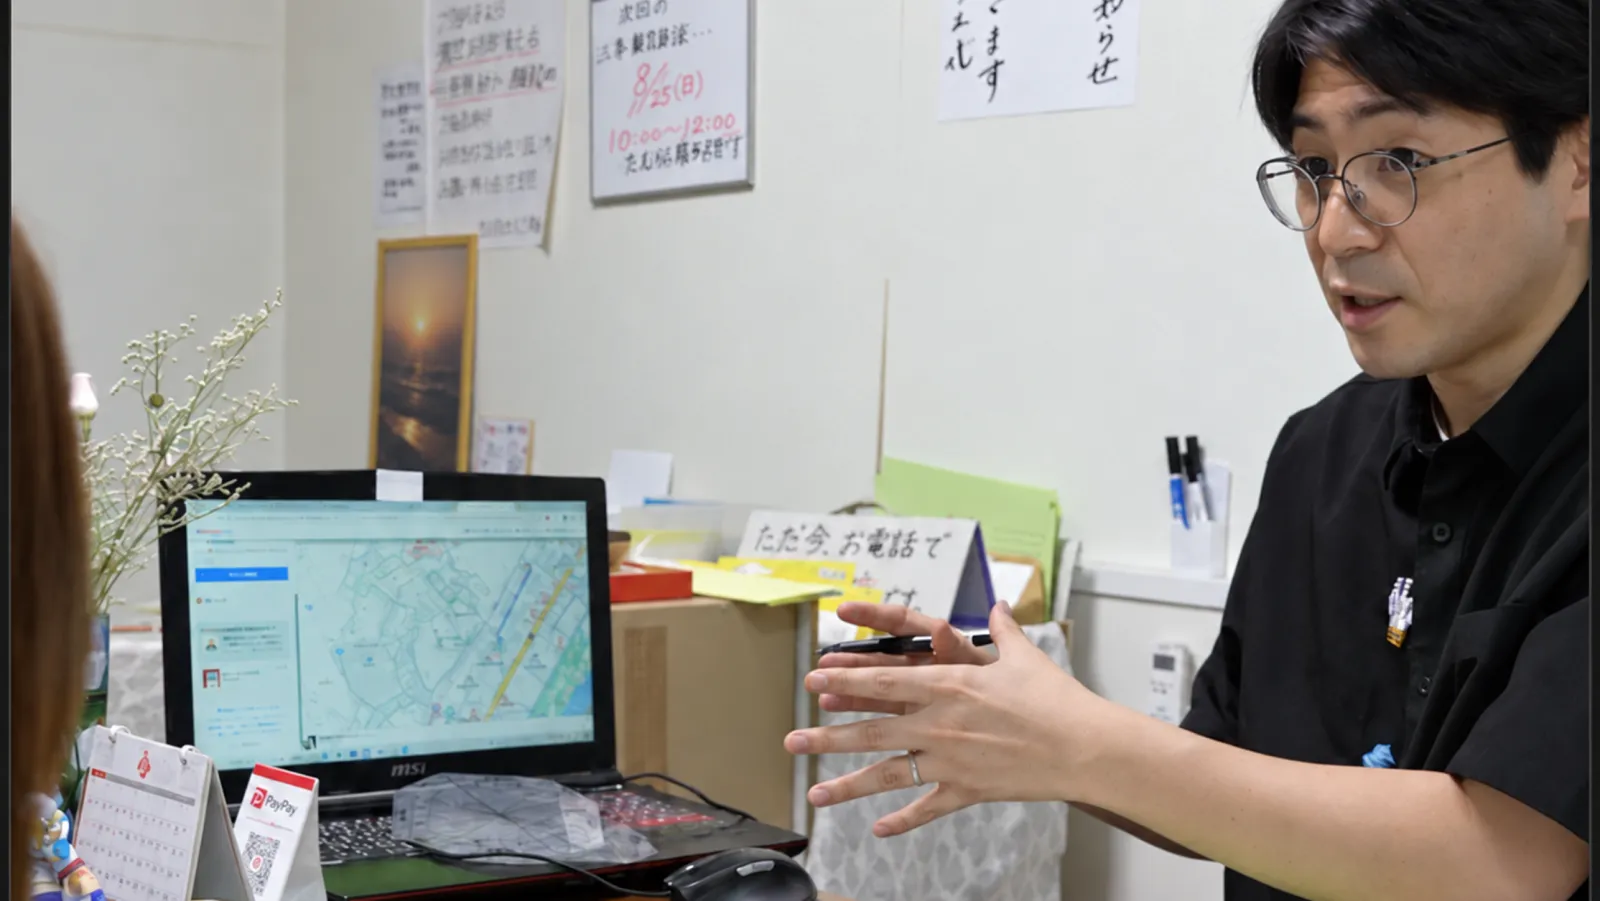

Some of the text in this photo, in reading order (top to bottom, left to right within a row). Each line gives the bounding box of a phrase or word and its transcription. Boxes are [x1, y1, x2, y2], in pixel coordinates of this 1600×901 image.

[754, 523, 952, 559] ただ今、お電話で
[265, 794, 298, 817] PayPay
